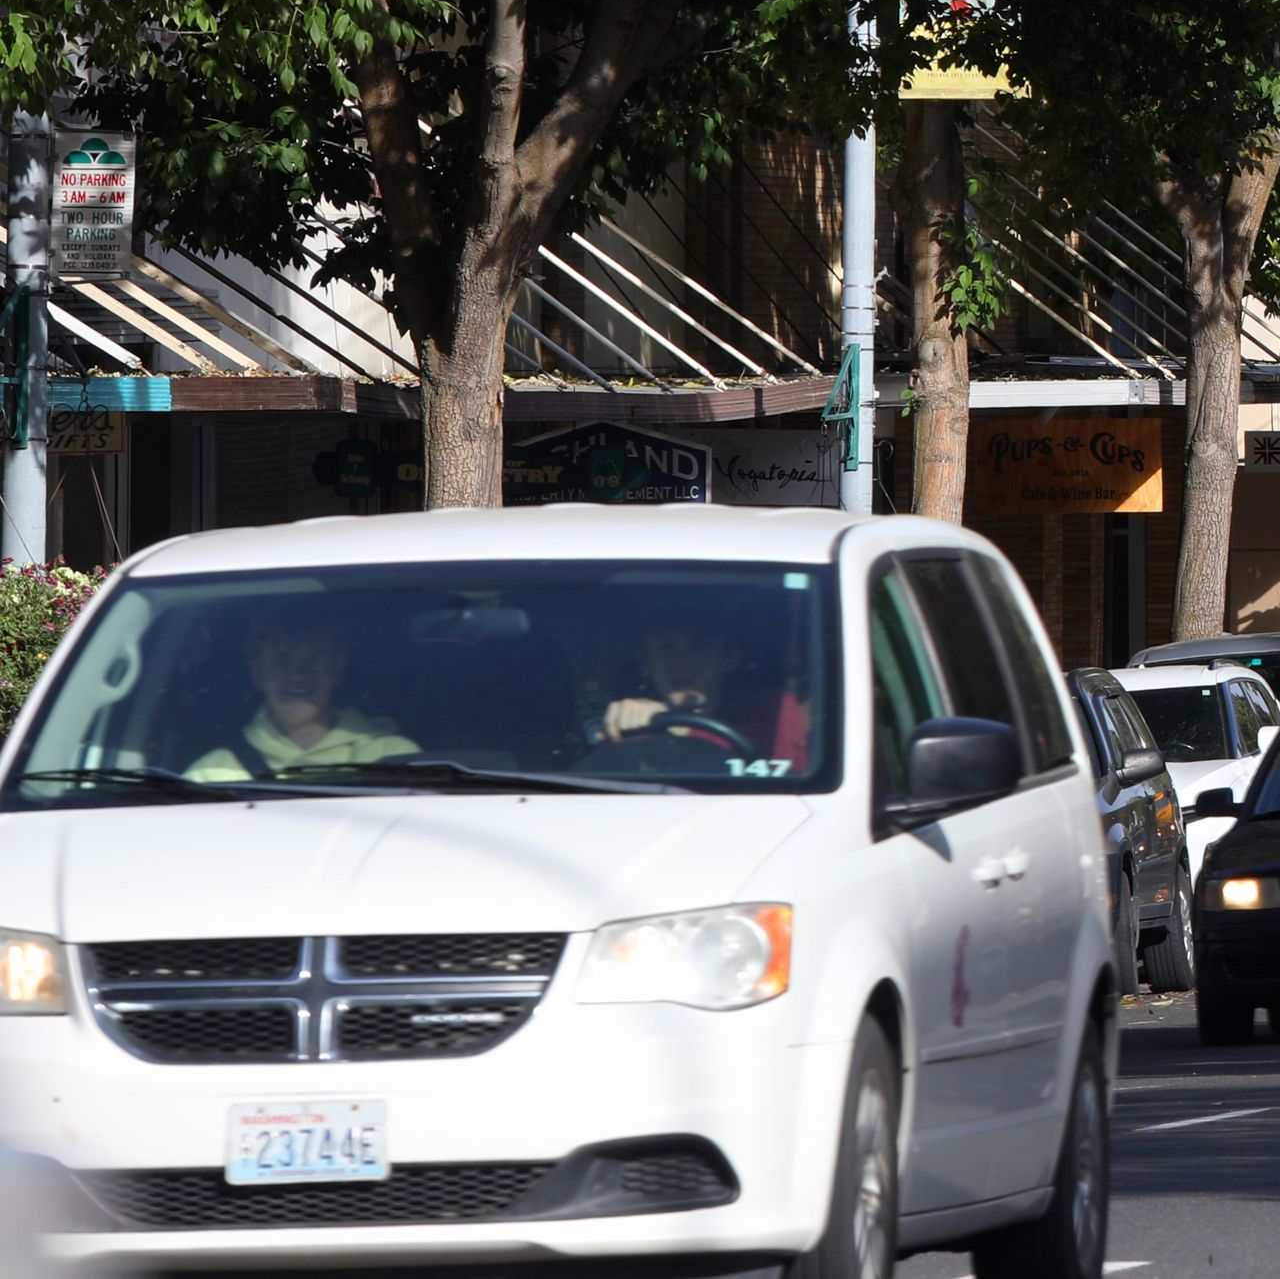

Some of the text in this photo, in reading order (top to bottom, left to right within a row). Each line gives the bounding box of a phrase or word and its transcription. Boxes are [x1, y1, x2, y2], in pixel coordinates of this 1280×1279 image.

[61, 174, 127, 187] NO PARKING
[61, 191, 68, 203] 3
[70, 191, 87, 203] AM
[99, 191, 107, 203] 6
[109, 191, 126, 203] AM
[61, 211, 124, 224] TWO HOUR
[66, 228, 116, 241] PARKING
[91, 244, 121, 252] SUNDAYS
[84, 253, 116, 261] HOLIDAYS
[674, 485, 700, 500] LLC
[724, 759, 792, 777] 147
